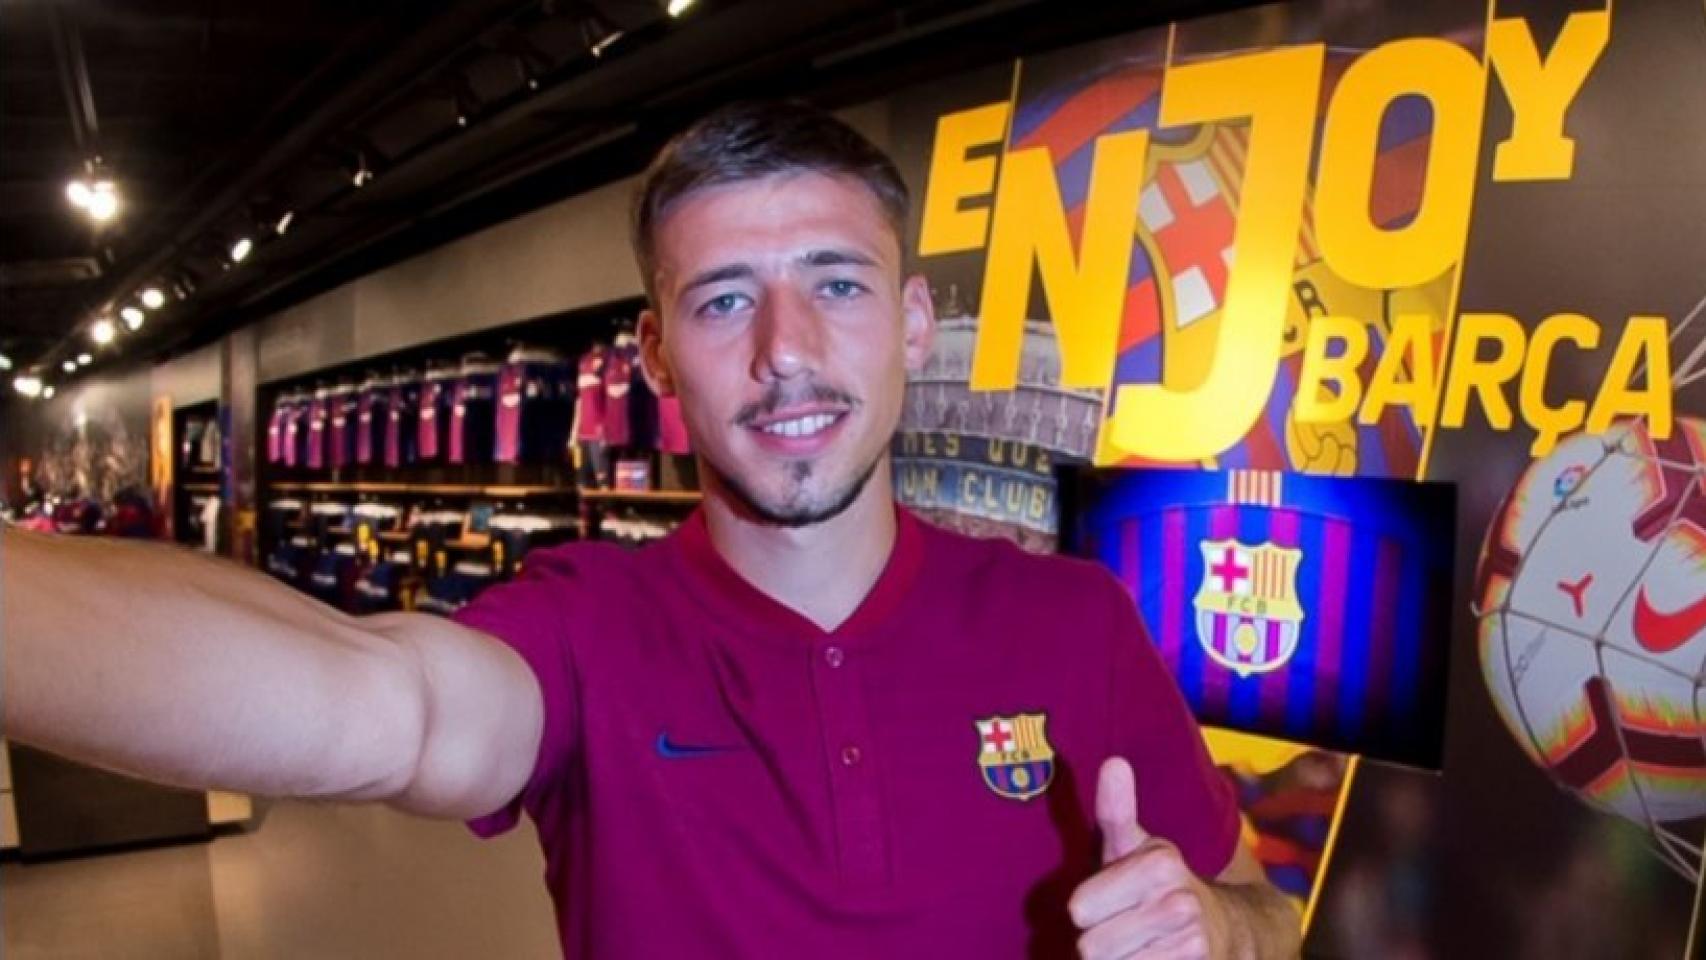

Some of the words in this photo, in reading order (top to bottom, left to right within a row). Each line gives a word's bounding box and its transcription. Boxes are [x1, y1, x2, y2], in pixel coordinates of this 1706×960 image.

[919, 9, 1611, 462] ENJOY
[1293, 313, 1673, 458] BARÇA
[963, 472, 1047, 519] CLUB
[1227, 596, 1268, 614] FCB
